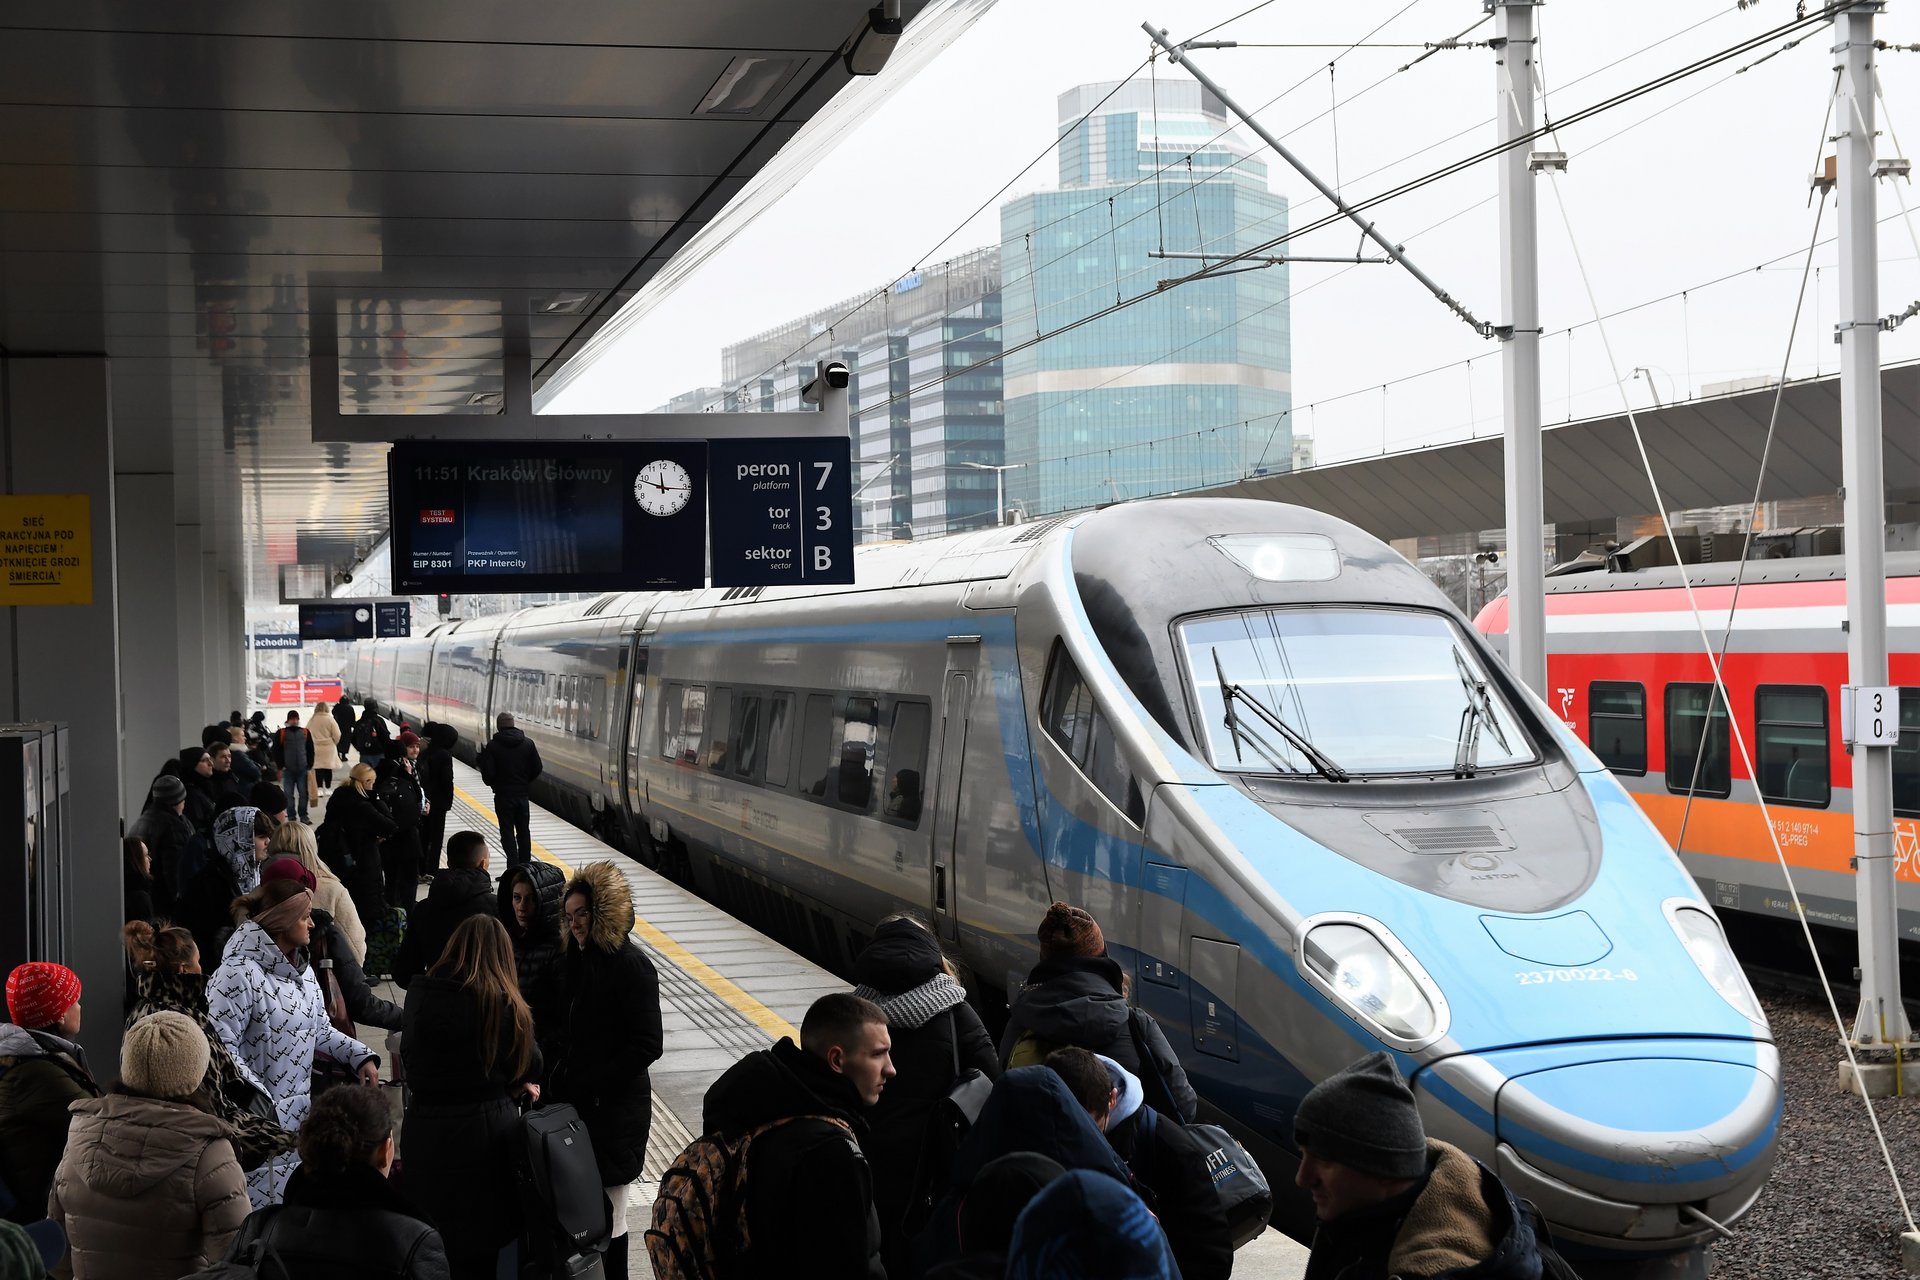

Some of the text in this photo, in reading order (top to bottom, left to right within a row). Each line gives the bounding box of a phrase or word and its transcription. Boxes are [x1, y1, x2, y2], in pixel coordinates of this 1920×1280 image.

[415, 465, 613, 485] 11:51 Kraków Główny
[737, 463, 790, 480] peron
[813, 461, 833, 491] 7
[752, 481, 790, 491] platform
[768, 506, 791, 519] tor
[815, 506, 833, 531] 3
[23, 515, 45, 526] SIEĆ
[772, 522, 791, 530] track
[0, 531, 74, 540] RAKCYJNA POD
[5, 543, 57, 555] NAPIĘCIEM
[745, 546, 792, 560] sektor
[50, 557, 80, 567] GROZI
[413, 559, 452, 568] EIP 8301
[467, 558, 527, 569] PKP Intercity
[814, 545, 832, 571] B
[770, 562, 792, 570] sector
[9, 568, 55, 581] ŚMIERCIĄ
[400, 607, 407, 616] 7
[400, 617, 406, 626] 3
[255, 637, 298, 647] achodnia
[1873, 693, 1883, 713] 3
[1873, 718, 1883, 738] 0
[1785, 820, 1791, 832] 2
[1470, 872, 1520, 881] ALSTOM
[1514, 968, 1640, 985] 2370022-8
[1215, 1164, 1237, 1181] FITNESS
